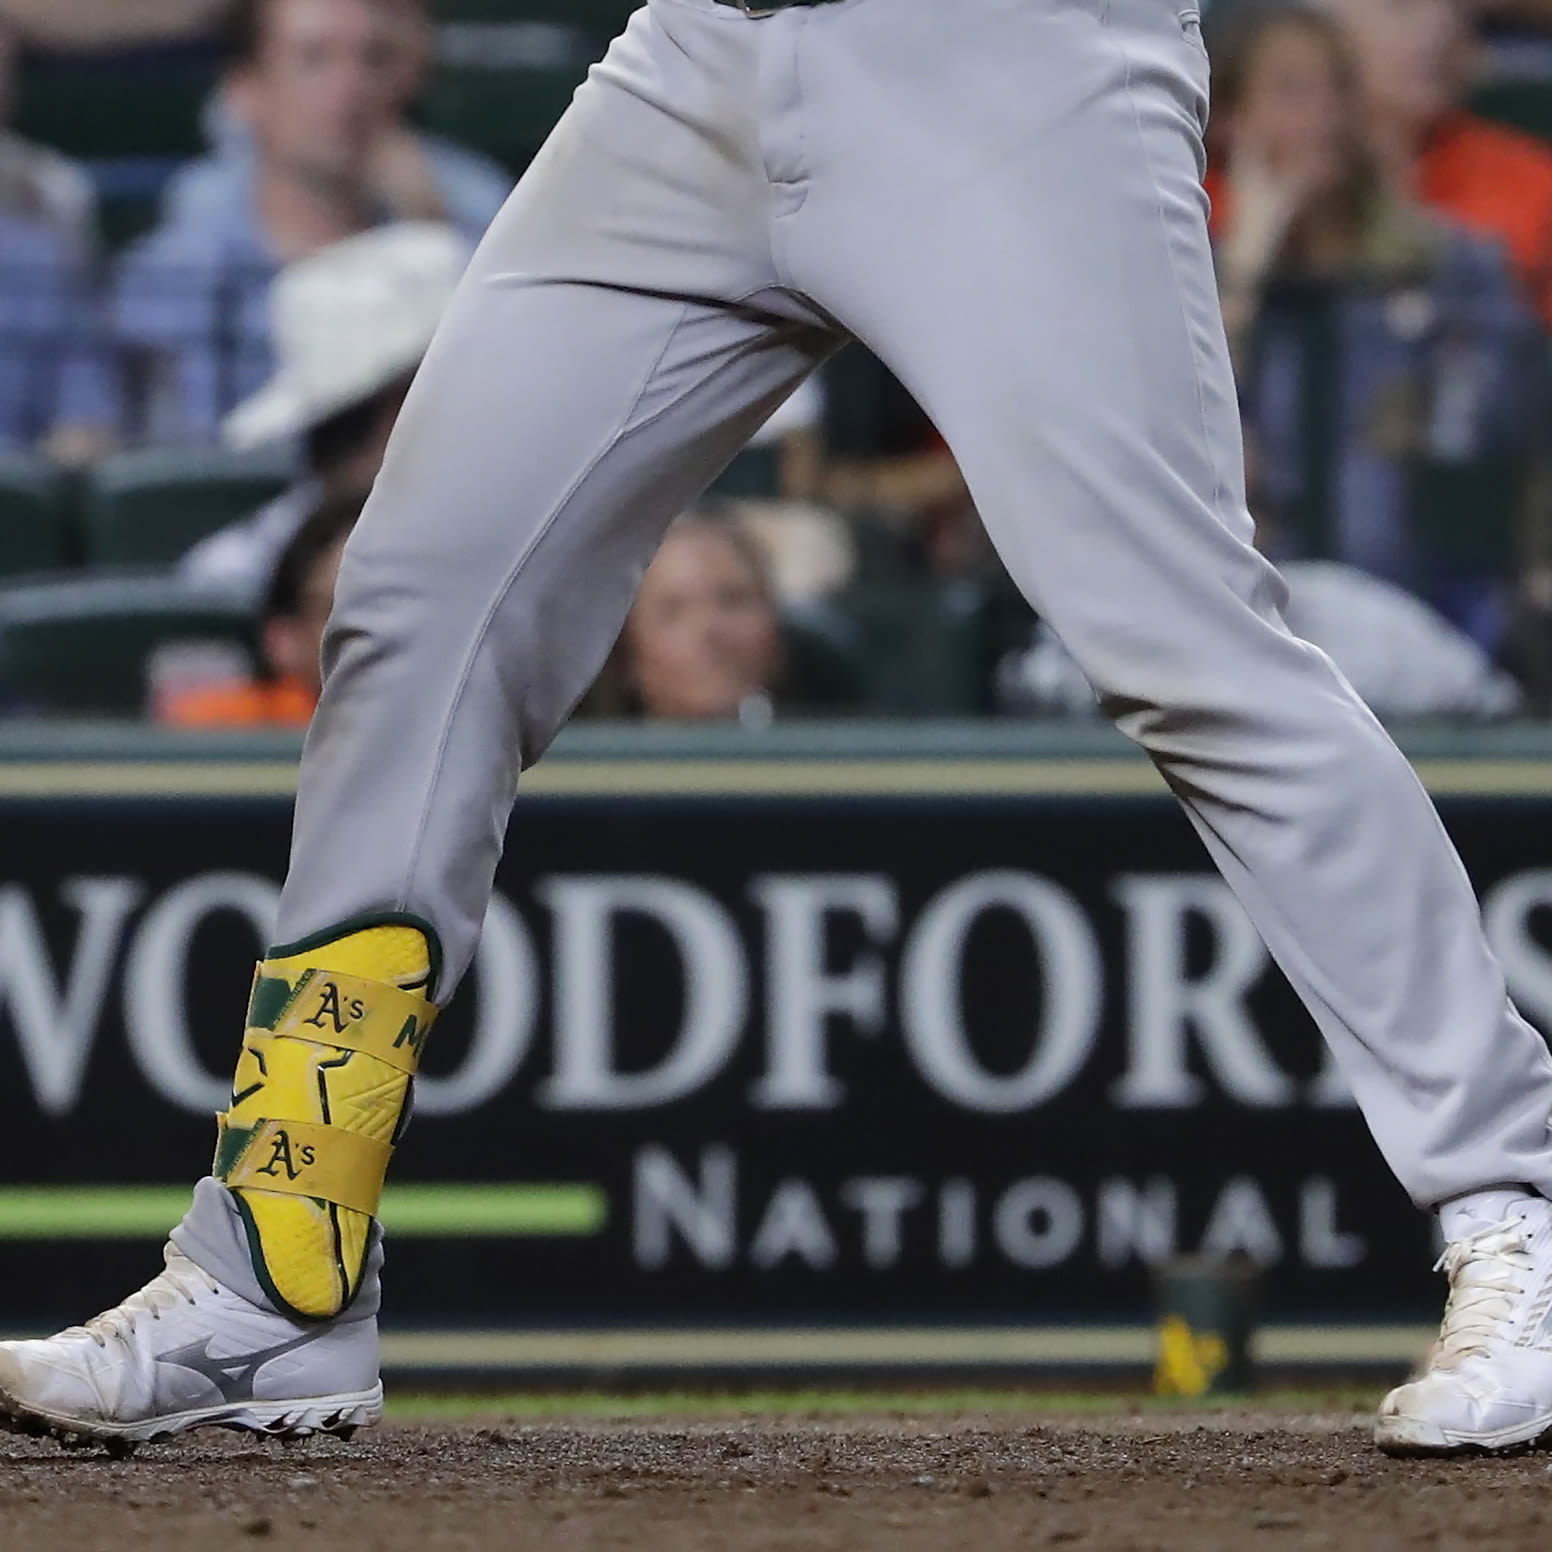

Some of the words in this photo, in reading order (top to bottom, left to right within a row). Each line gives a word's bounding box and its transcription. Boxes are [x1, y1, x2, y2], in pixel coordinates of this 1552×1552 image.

[303, 982, 365, 1034] A's
[256, 1130, 315, 1181] A's
[633, 1143, 1366, 1270] NATIONAL
